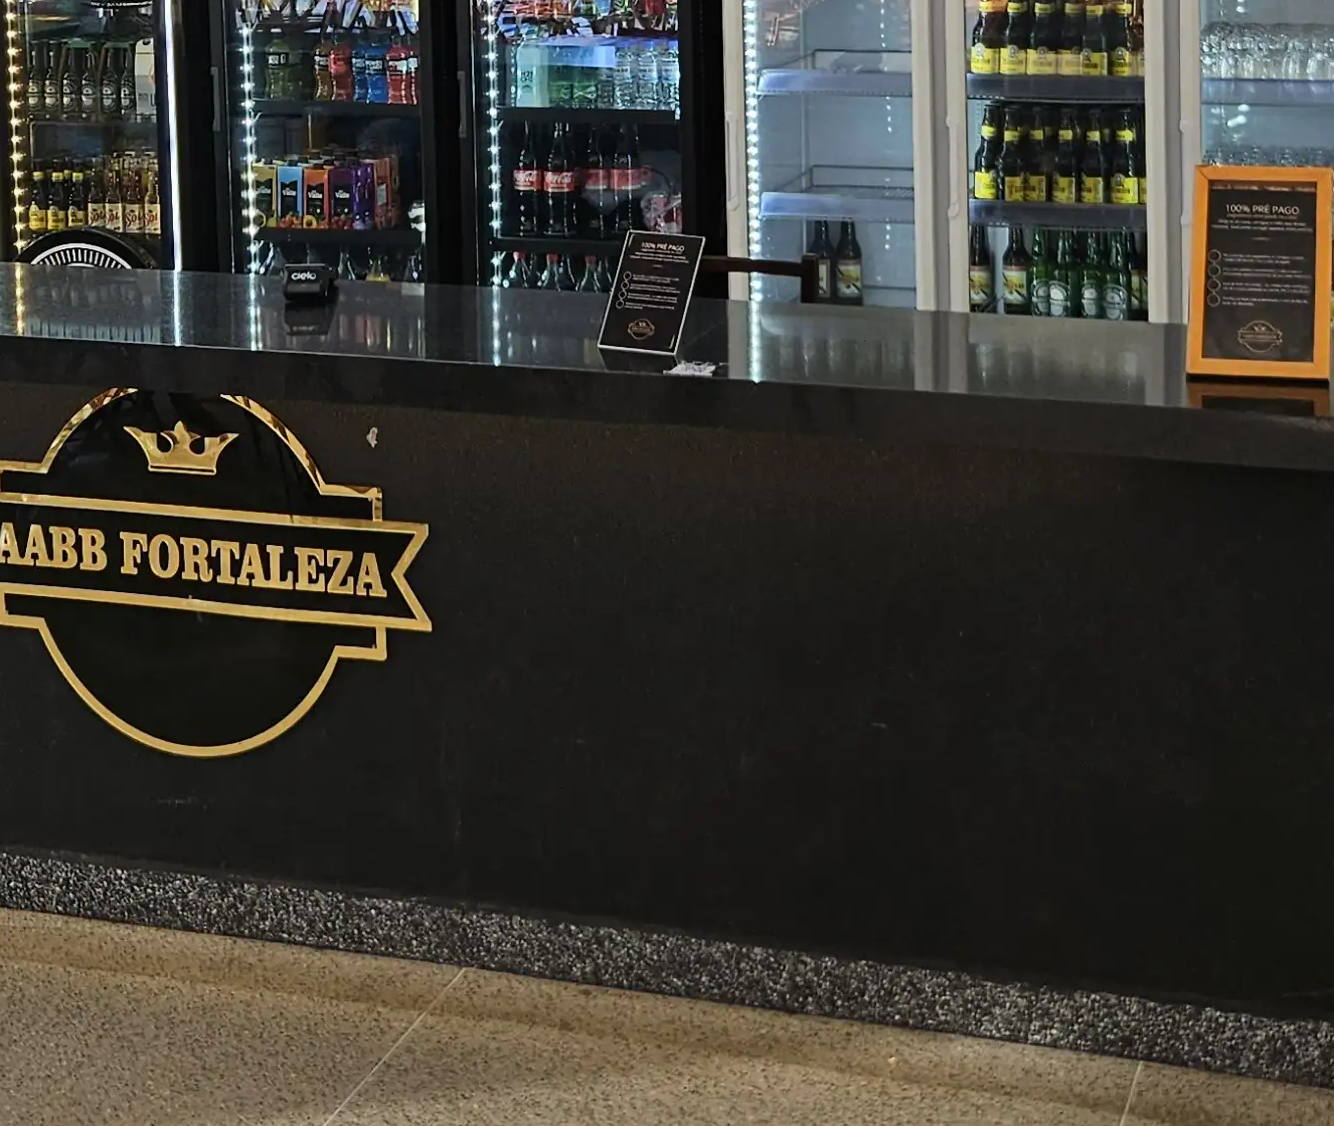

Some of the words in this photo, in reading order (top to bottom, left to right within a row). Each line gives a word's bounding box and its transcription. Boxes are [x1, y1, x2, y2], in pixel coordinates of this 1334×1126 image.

[1226, 204, 1250, 213] 100%
[1272, 206, 1300, 215] PAGO
[291, 271, 316, 280] cielo
[120, 531, 388, 597] FORTALEZA
